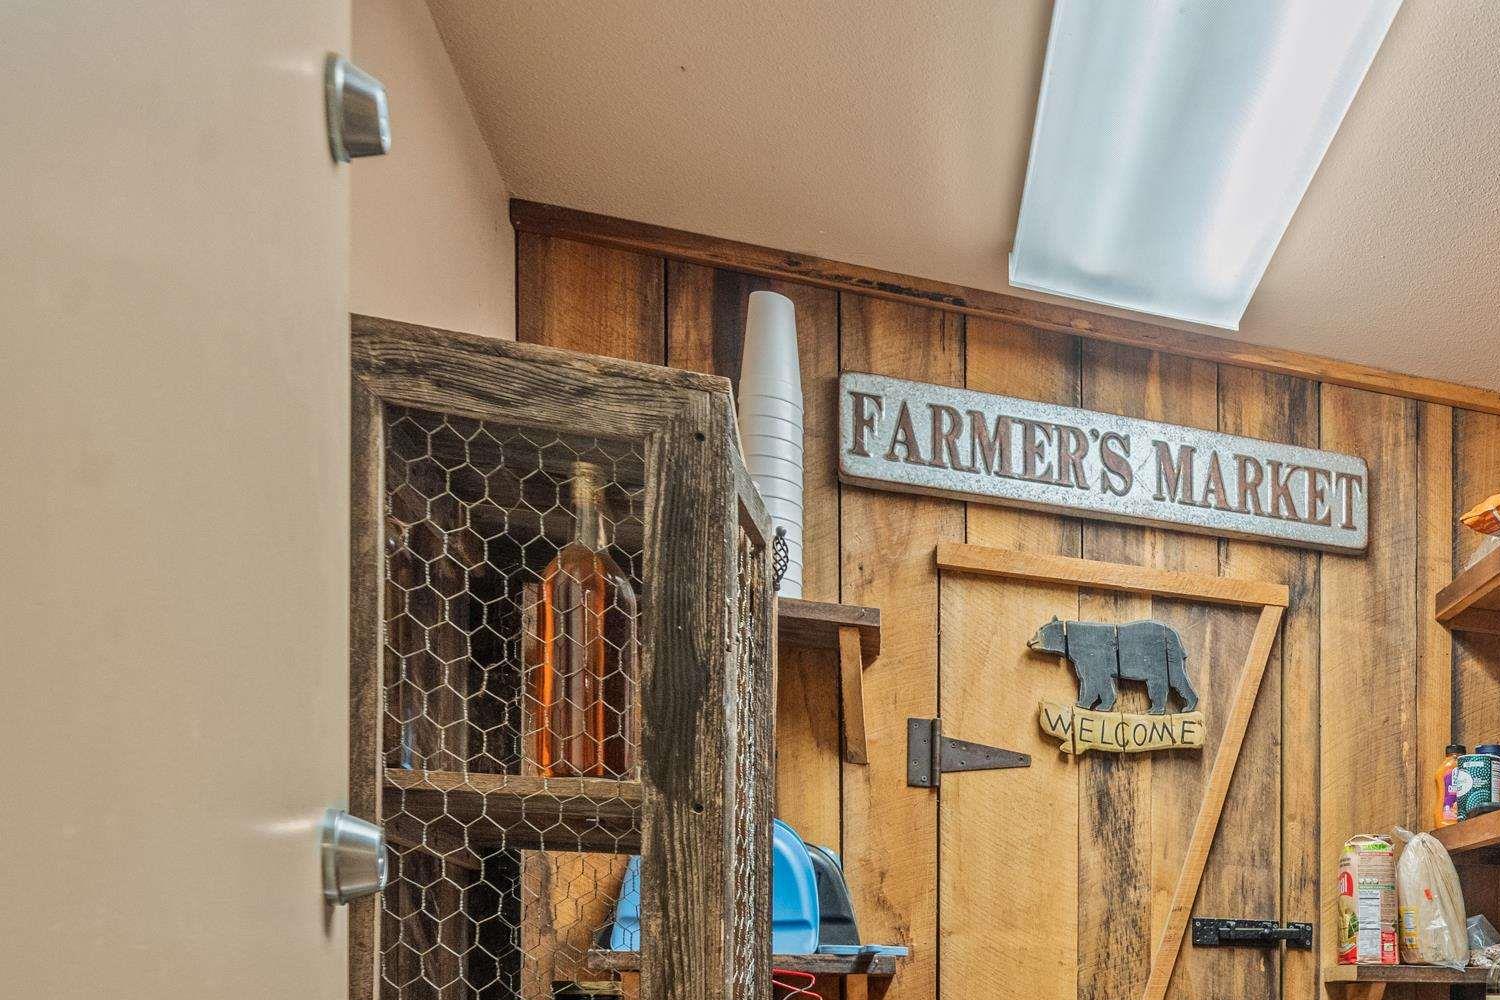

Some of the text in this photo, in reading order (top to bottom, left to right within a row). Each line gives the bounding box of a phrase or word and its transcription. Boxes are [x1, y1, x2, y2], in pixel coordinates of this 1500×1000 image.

[848, 390, 1364, 532] FARMER'S MARKET
[1043, 713, 1197, 748] WELCOME
